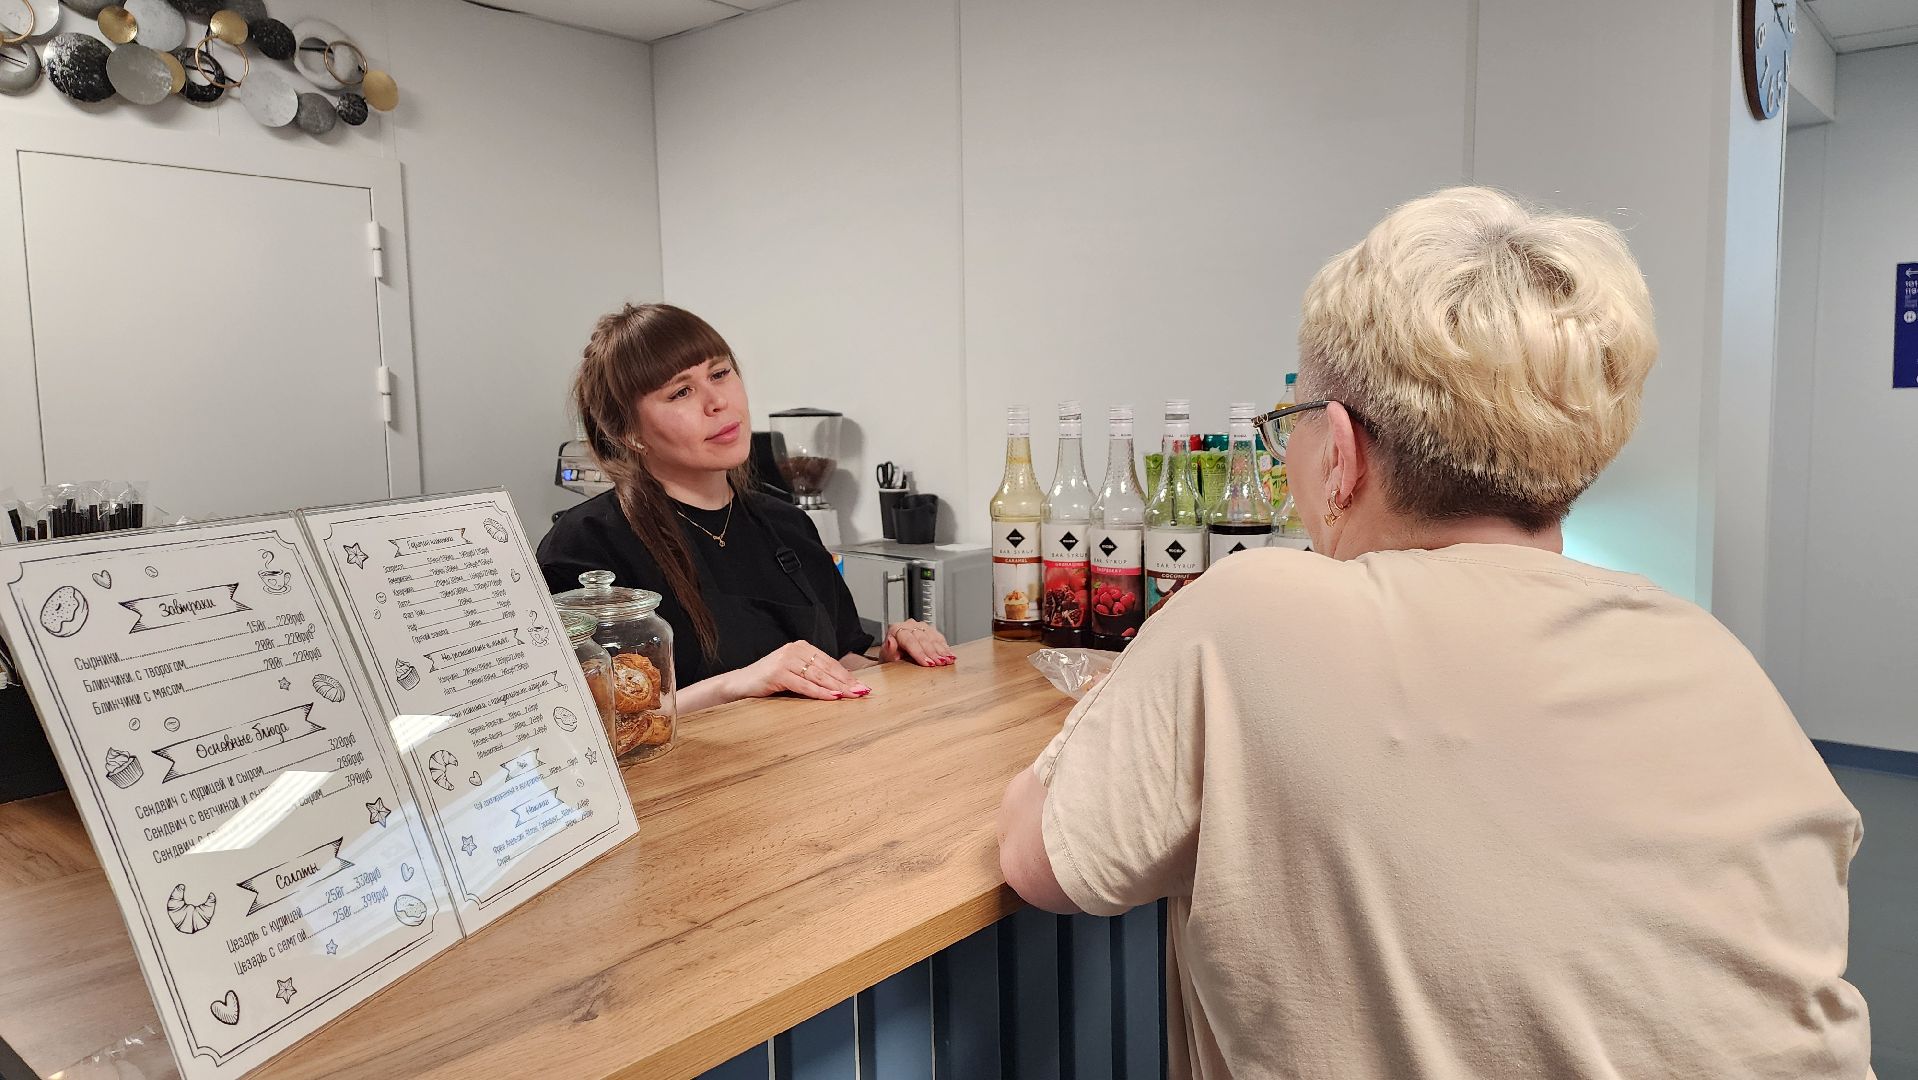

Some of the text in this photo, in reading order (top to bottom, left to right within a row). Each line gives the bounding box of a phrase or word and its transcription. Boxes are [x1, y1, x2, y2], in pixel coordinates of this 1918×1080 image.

[158, 597, 217, 619] Завтраки
[74, 652, 121, 672] Сырники
[246, 620, 267, 634] 150г
[83, 671, 133, 693] Блинчики
[134, 668, 143, 682] с
[145, 658, 187, 681] творогом
[255, 636, 276, 651] 200г
[92, 694, 142, 716] Блинчики
[143, 688, 152, 702] с
[153, 681, 186, 700] мясом
[263, 656, 284, 671] 200г
[195, 721, 291, 759] Основные блюда
[134, 794, 178, 820] Сендвич
[180, 791, 188, 804] с
[189, 776, 227, 803] курицей
[228, 776, 236, 788] и
[236, 765, 265, 786] сыром
[143, 816, 187, 842] Сендвич
[188, 813, 197, 826] с
[198, 796, 241, 822] ветчиной
[241, 794, 249, 806] и
[152, 838, 196, 864] Сендвич
[275, 862, 320, 890] Салаты
[226, 930, 260, 954] Цезарь
[261, 924, 269, 936] с
[270, 907, 304, 936] курицей
[233, 951, 268, 976] Цезарь
[268, 945, 276, 958] с
[277, 928, 308, 954] семгой
